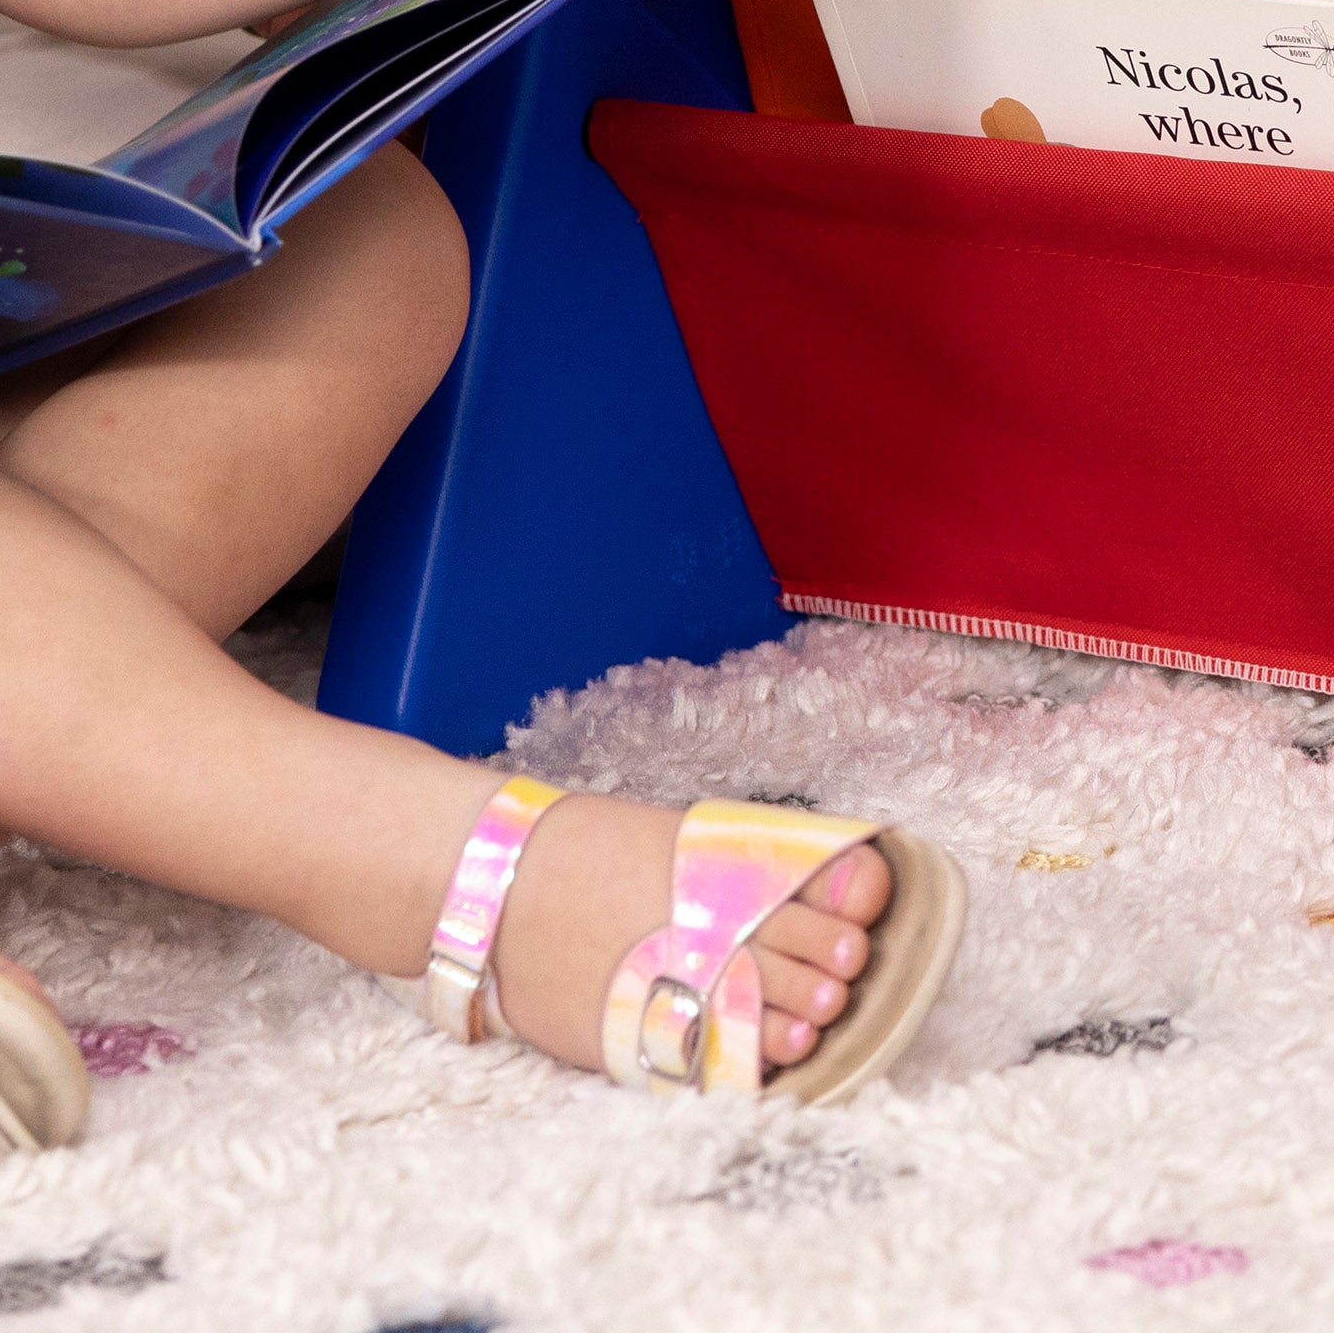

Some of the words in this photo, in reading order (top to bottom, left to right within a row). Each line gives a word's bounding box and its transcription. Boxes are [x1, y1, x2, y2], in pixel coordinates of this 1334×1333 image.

[1274, 34, 1313, 45] DRAGONFLY
[1289, 49, 1311, 58] BOOKS
[1096, 46, 1304, 113] Nicolas,
[1138, 106, 1296, 157] where
